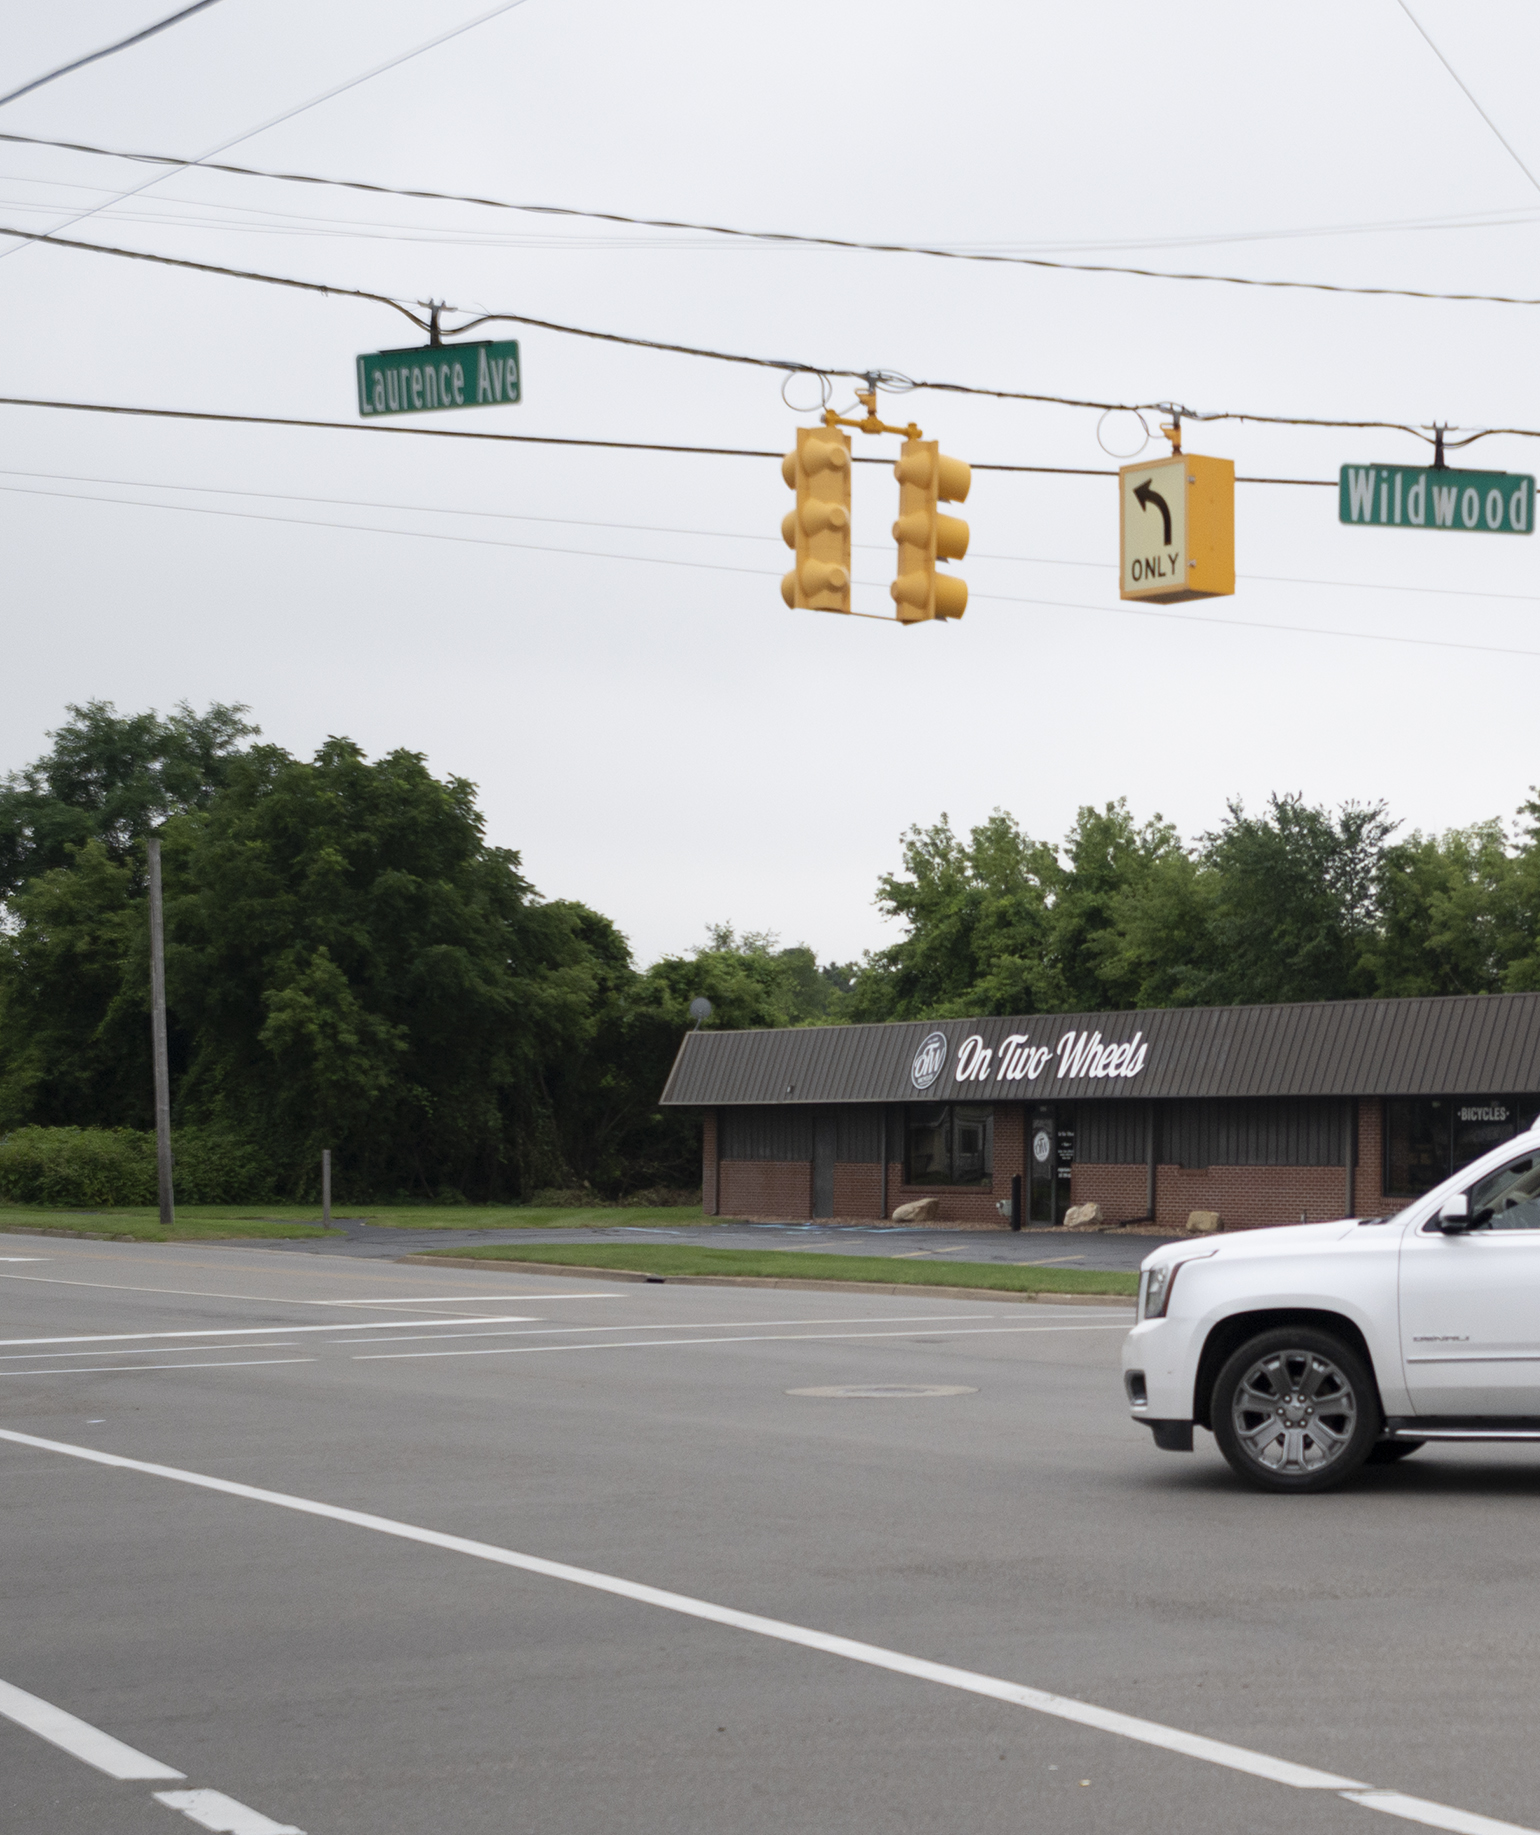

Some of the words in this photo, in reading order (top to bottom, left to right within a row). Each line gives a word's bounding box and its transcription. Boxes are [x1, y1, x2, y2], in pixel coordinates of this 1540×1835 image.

[359, 359, 465, 414] Laurence
[477, 347, 518, 403] Ave
[1348, 468, 1528, 531] Wildwood
[1131, 552, 1179, 582] ONLY
[956, 1035, 993, 1082] On
[996, 1034, 1053, 1081] Two
[1056, 1031, 1148, 1079] Wheels
[1461, 1107, 1506, 1121] BICYCLES
